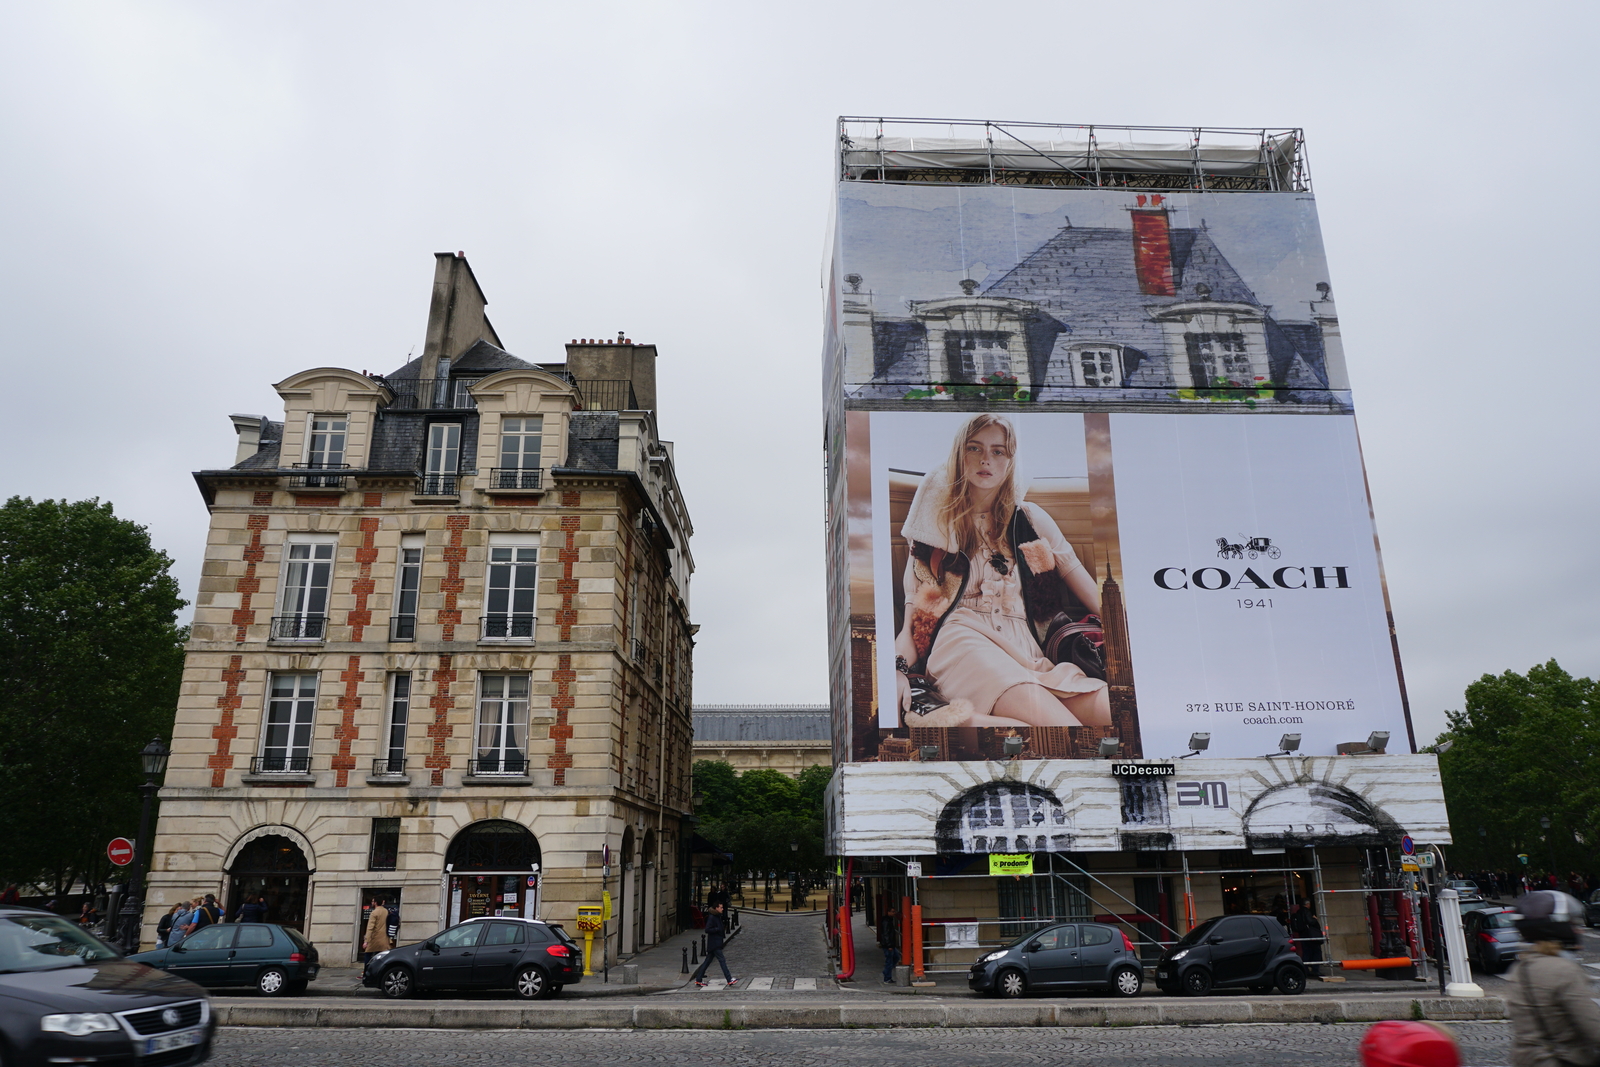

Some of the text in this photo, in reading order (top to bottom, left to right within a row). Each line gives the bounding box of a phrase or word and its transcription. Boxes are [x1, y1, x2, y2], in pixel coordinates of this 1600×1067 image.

[1153, 566, 1352, 590] COACH
[1237, 598, 1273, 609] 1941
[1186, 698, 1355, 713] 372 RUE SAINT-HONORÉ
[1243, 714, 1304, 725] coach.com
[1113, 765, 1174, 775] JCDecaux
